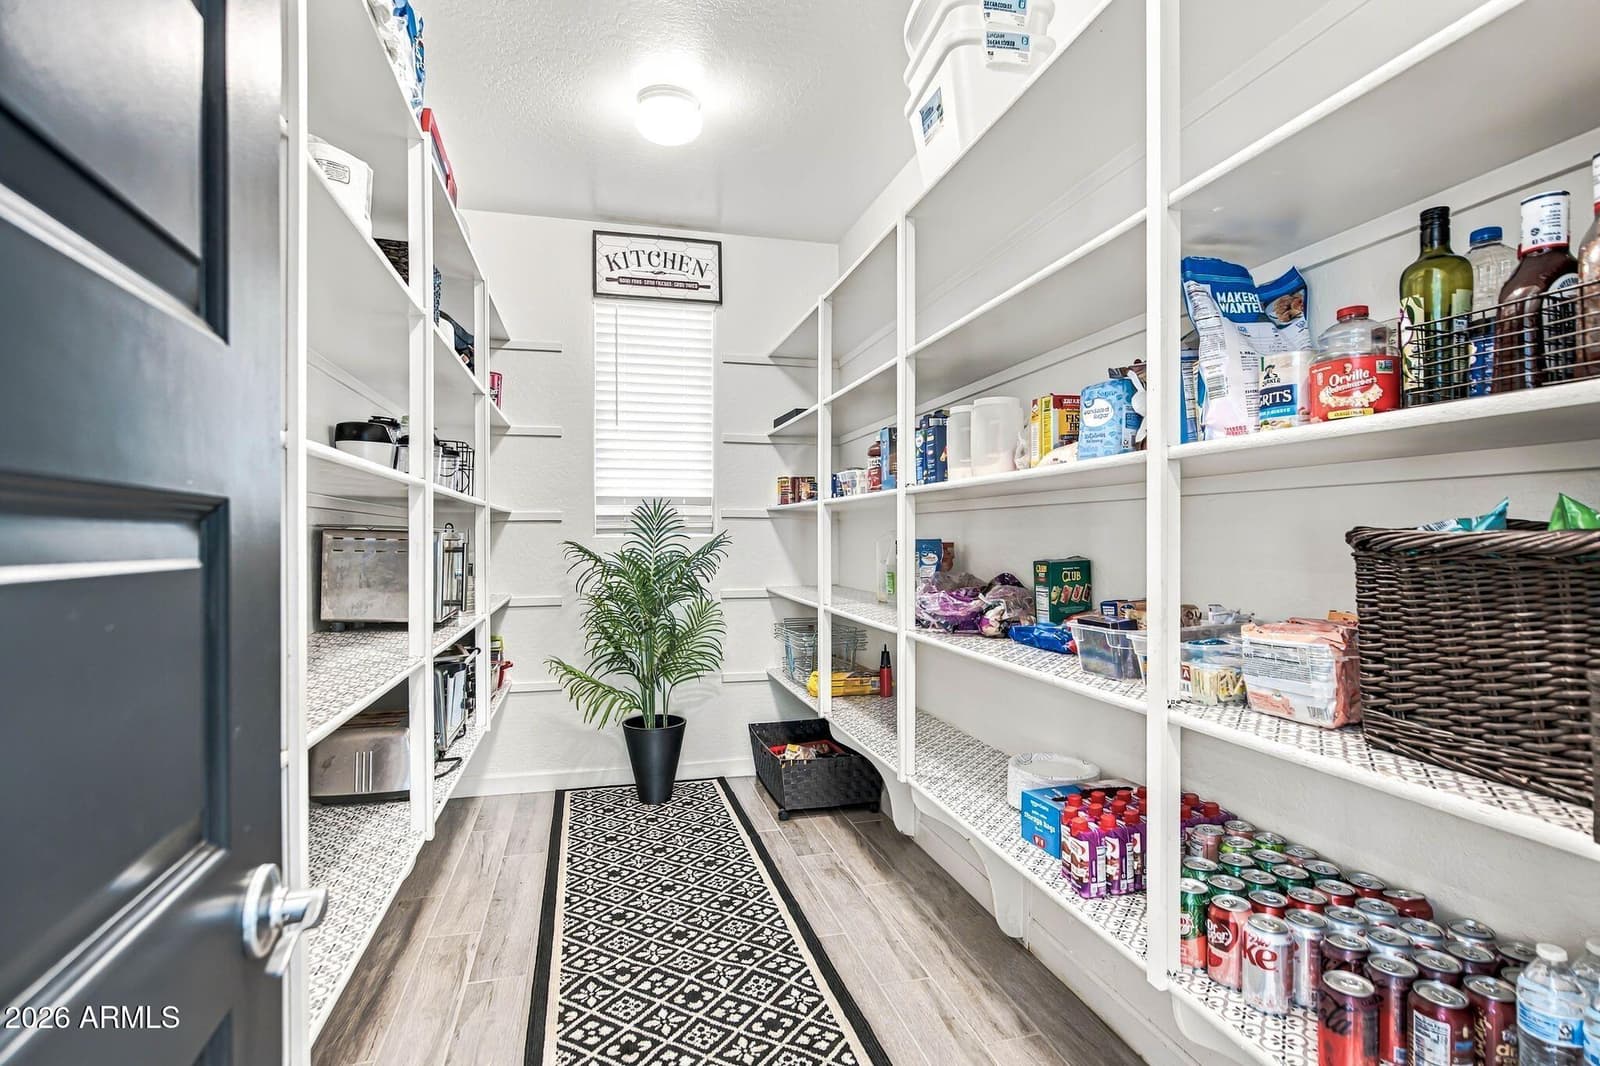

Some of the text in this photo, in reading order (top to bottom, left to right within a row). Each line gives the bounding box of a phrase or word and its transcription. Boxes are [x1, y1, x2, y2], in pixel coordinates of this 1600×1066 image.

[605, 250, 709, 278] KITCHEN
[1329, 368, 1370, 387] Orville
[1066, 414, 1080, 423] FIS
[1062, 570, 1082, 583] CLUB
[1206, 919, 1218, 931] Dr
